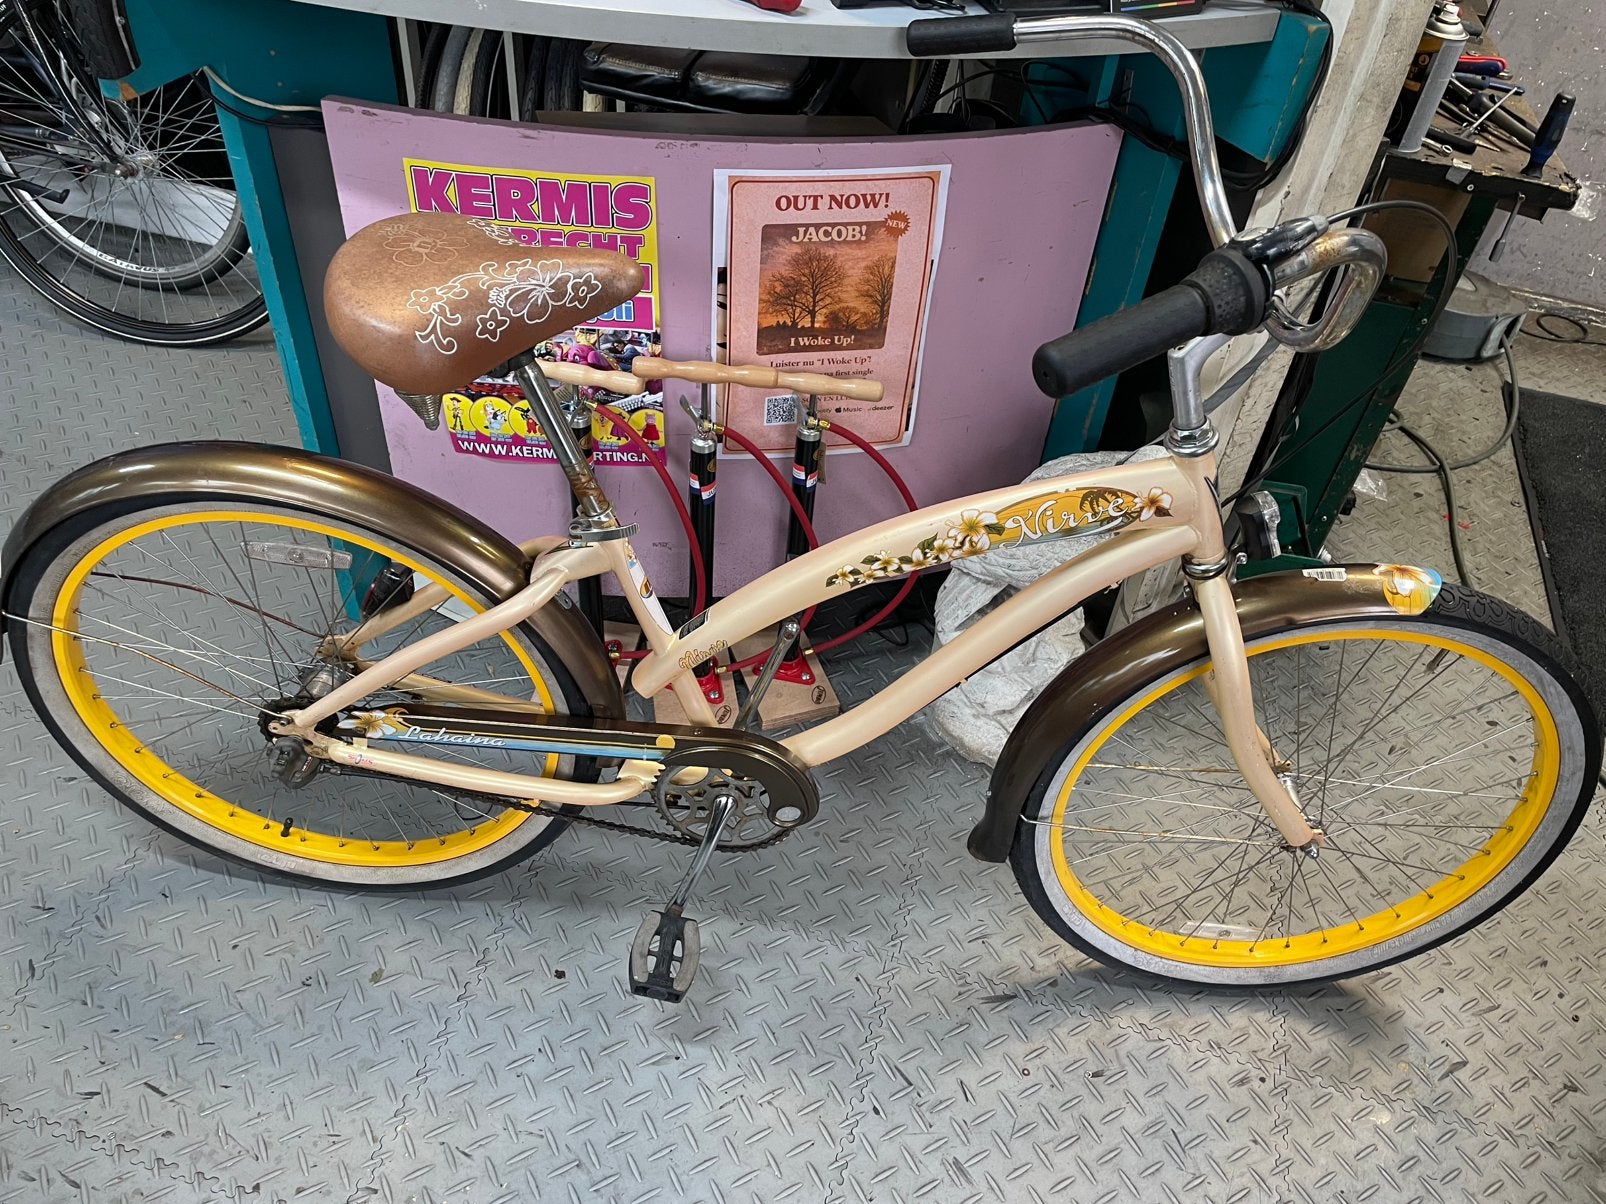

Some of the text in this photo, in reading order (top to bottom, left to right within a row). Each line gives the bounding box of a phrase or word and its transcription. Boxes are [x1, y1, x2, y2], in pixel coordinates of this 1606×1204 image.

[410, 165, 652, 231] KERMIS
[775, 192, 890, 212] OUT NOW!
[885, 218, 906, 230] NEW
[791, 225, 867, 242] JACOB!
[585, 300, 634, 323] uli
[790, 335, 855, 347] I Woke Up!
[827, 357, 852, 365] Woke
[852, 368, 874, 377] single
[871, 404, 895, 412] deezer
[999, 498, 1129, 549] Nirve
[398, 725, 506, 747] Lahaina
